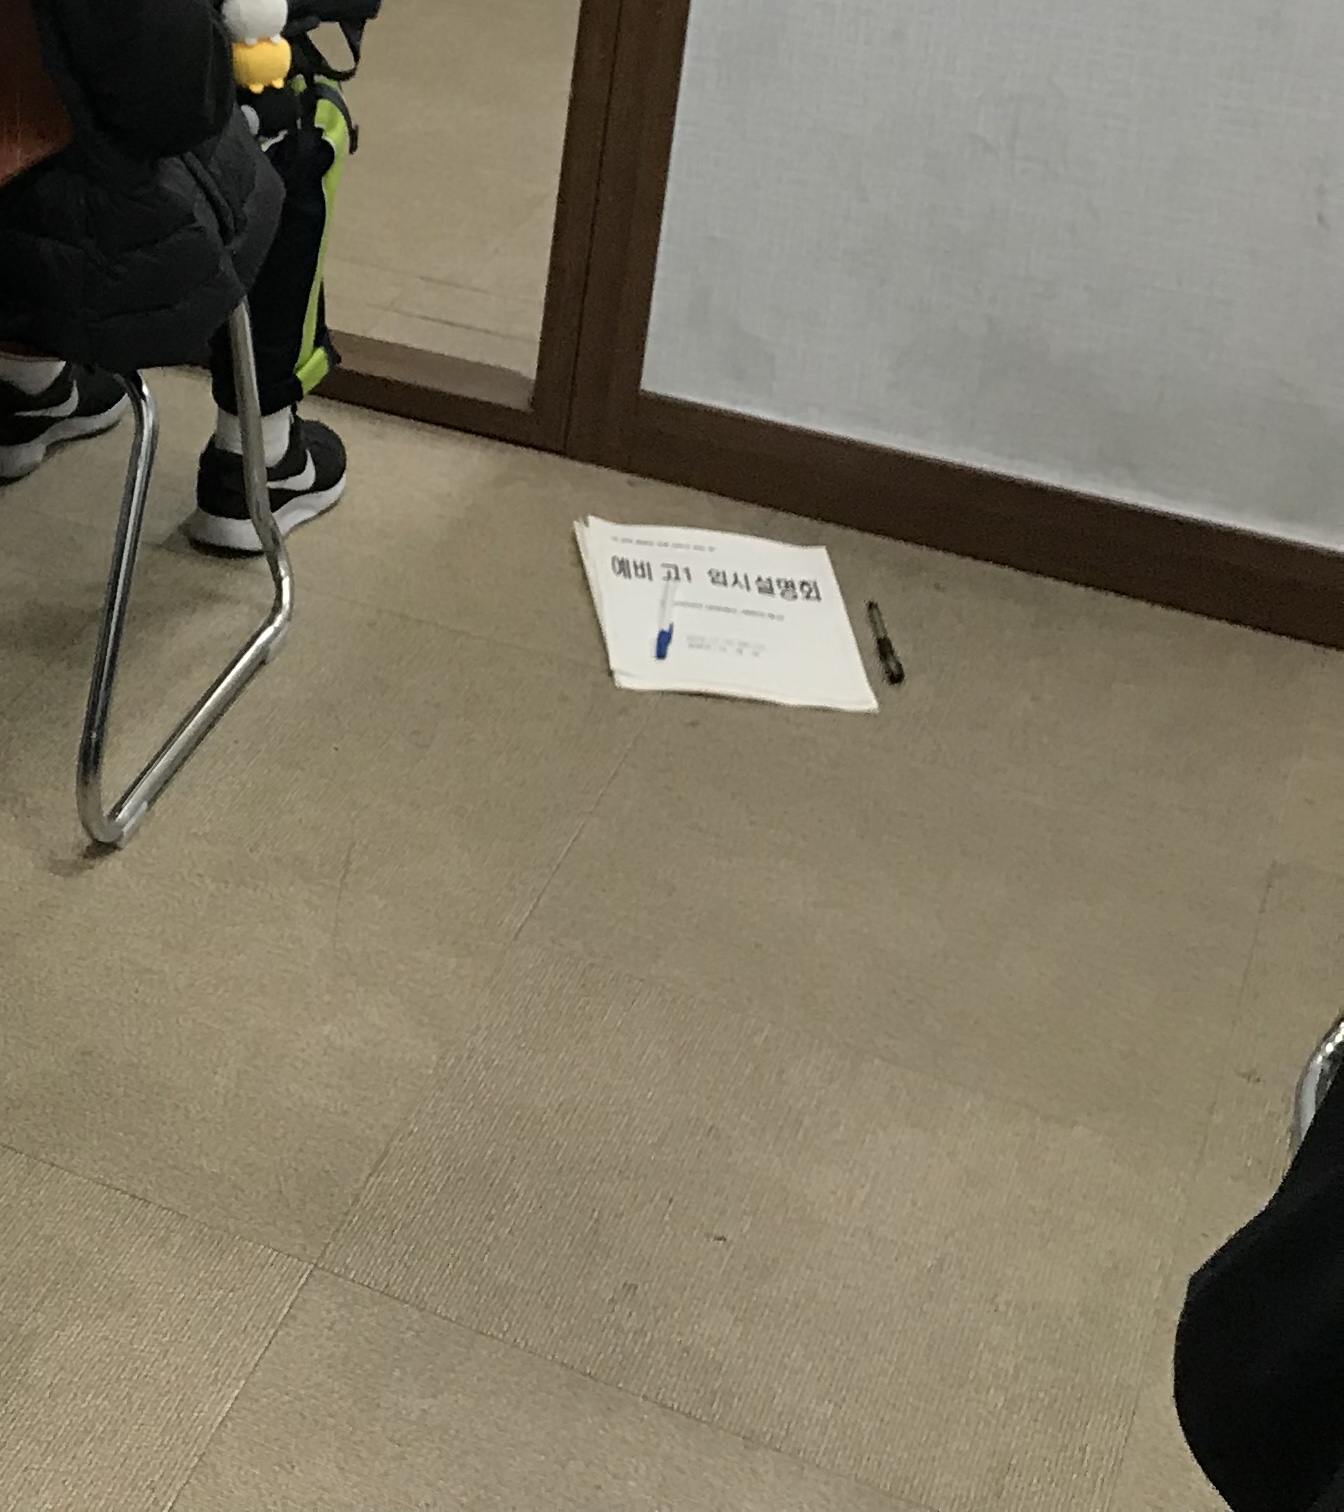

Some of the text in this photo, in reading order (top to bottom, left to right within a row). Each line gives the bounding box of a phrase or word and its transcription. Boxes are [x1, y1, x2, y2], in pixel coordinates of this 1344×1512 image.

[611, 554, 823, 602] 예비 고1 입시설명회
